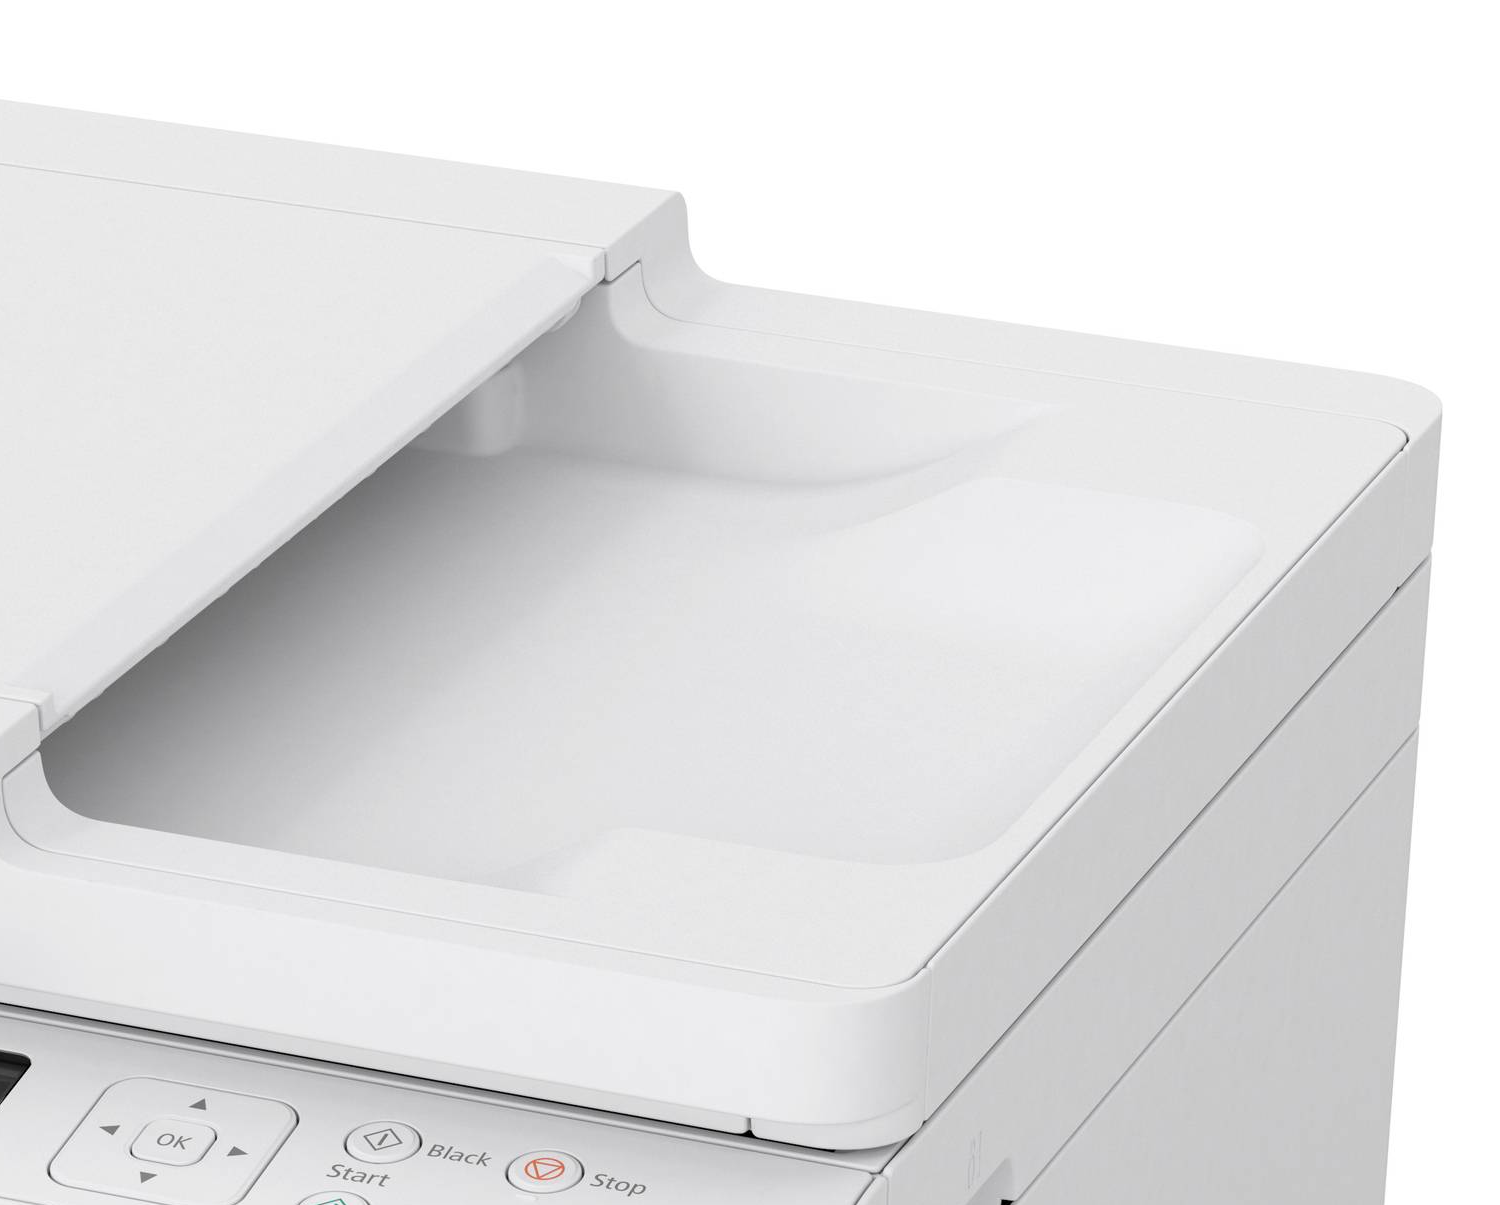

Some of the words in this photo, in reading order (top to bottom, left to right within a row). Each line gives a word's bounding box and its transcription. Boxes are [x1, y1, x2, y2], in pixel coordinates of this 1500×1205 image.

[156, 1133, 192, 1150] OK
[427, 1144, 492, 1167] Black
[327, 1163, 391, 1188] Start
[590, 1173, 647, 1198] Stop
